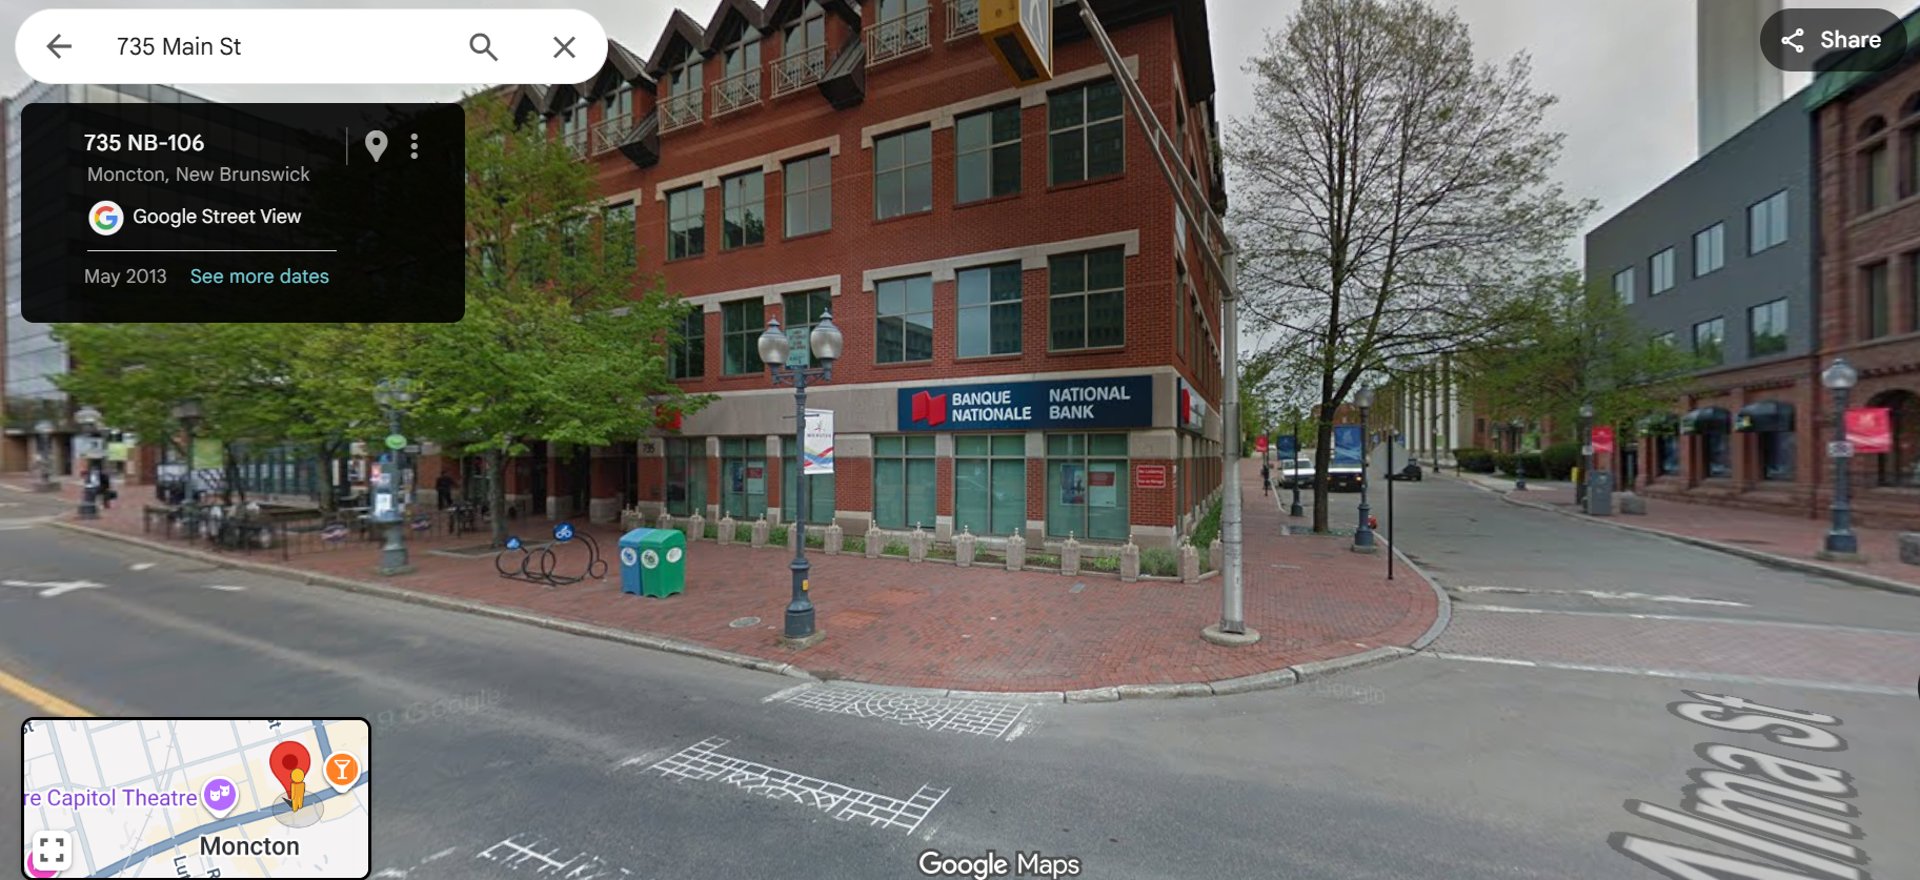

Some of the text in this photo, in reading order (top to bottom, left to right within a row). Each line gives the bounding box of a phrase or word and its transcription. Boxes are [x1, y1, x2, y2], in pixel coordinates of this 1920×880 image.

[952, 390, 1011, 406] BANQUE
[1049, 386, 1131, 402] NATIONAL
[952, 406, 1032, 422] NATIONALE
[1049, 404, 1095, 420] BANK
